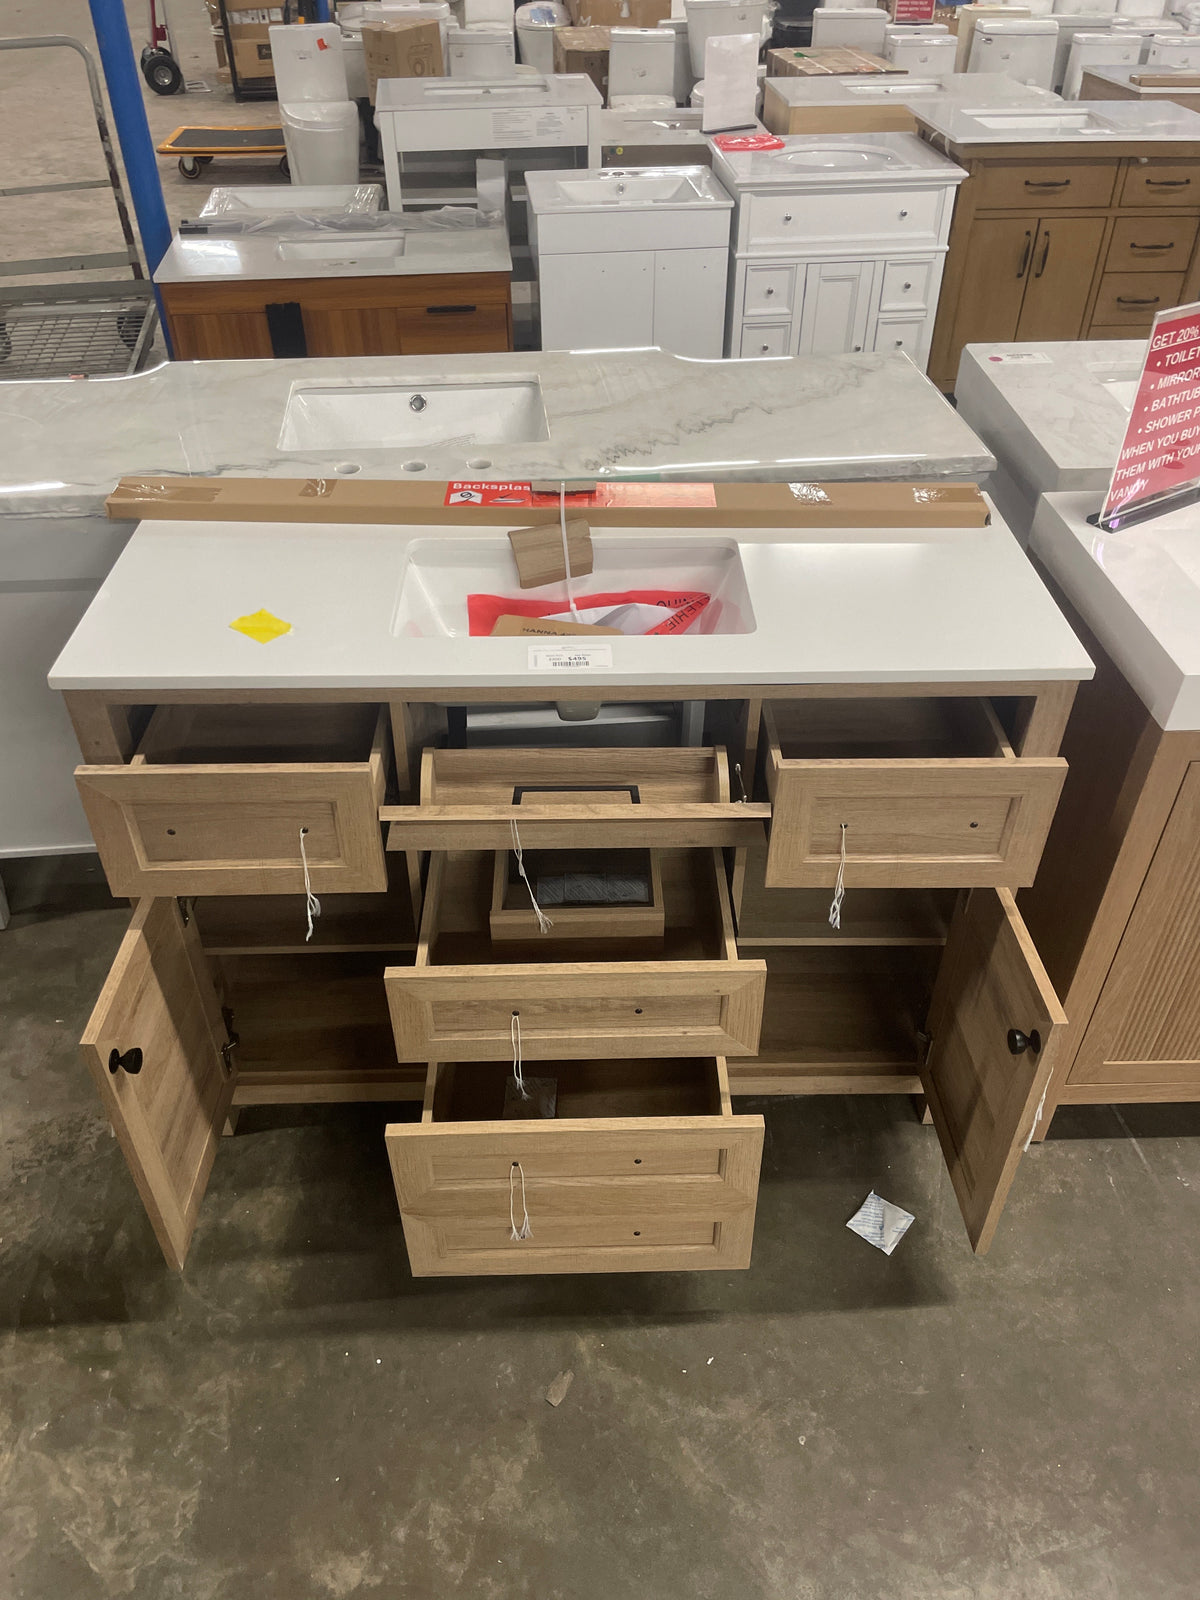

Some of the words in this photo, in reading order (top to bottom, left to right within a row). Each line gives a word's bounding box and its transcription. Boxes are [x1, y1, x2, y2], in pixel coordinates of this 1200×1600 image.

[1152, 331, 1177, 349] GET
[1176, 325, 1200, 343] 20%
[1157, 366, 1200, 391] MIRROR
[1144, 410, 1192, 434] SHOWER
[1193, 406, 1200, 419] P
[1121, 442, 1154, 461] WHEN
[1157, 432, 1179, 449] YOU
[1180, 425, 1200, 441] BUY
[1116, 461, 1146, 482] THEM
[1147, 452, 1175, 471] WITH
[453, 482, 531, 491] Backsplas
